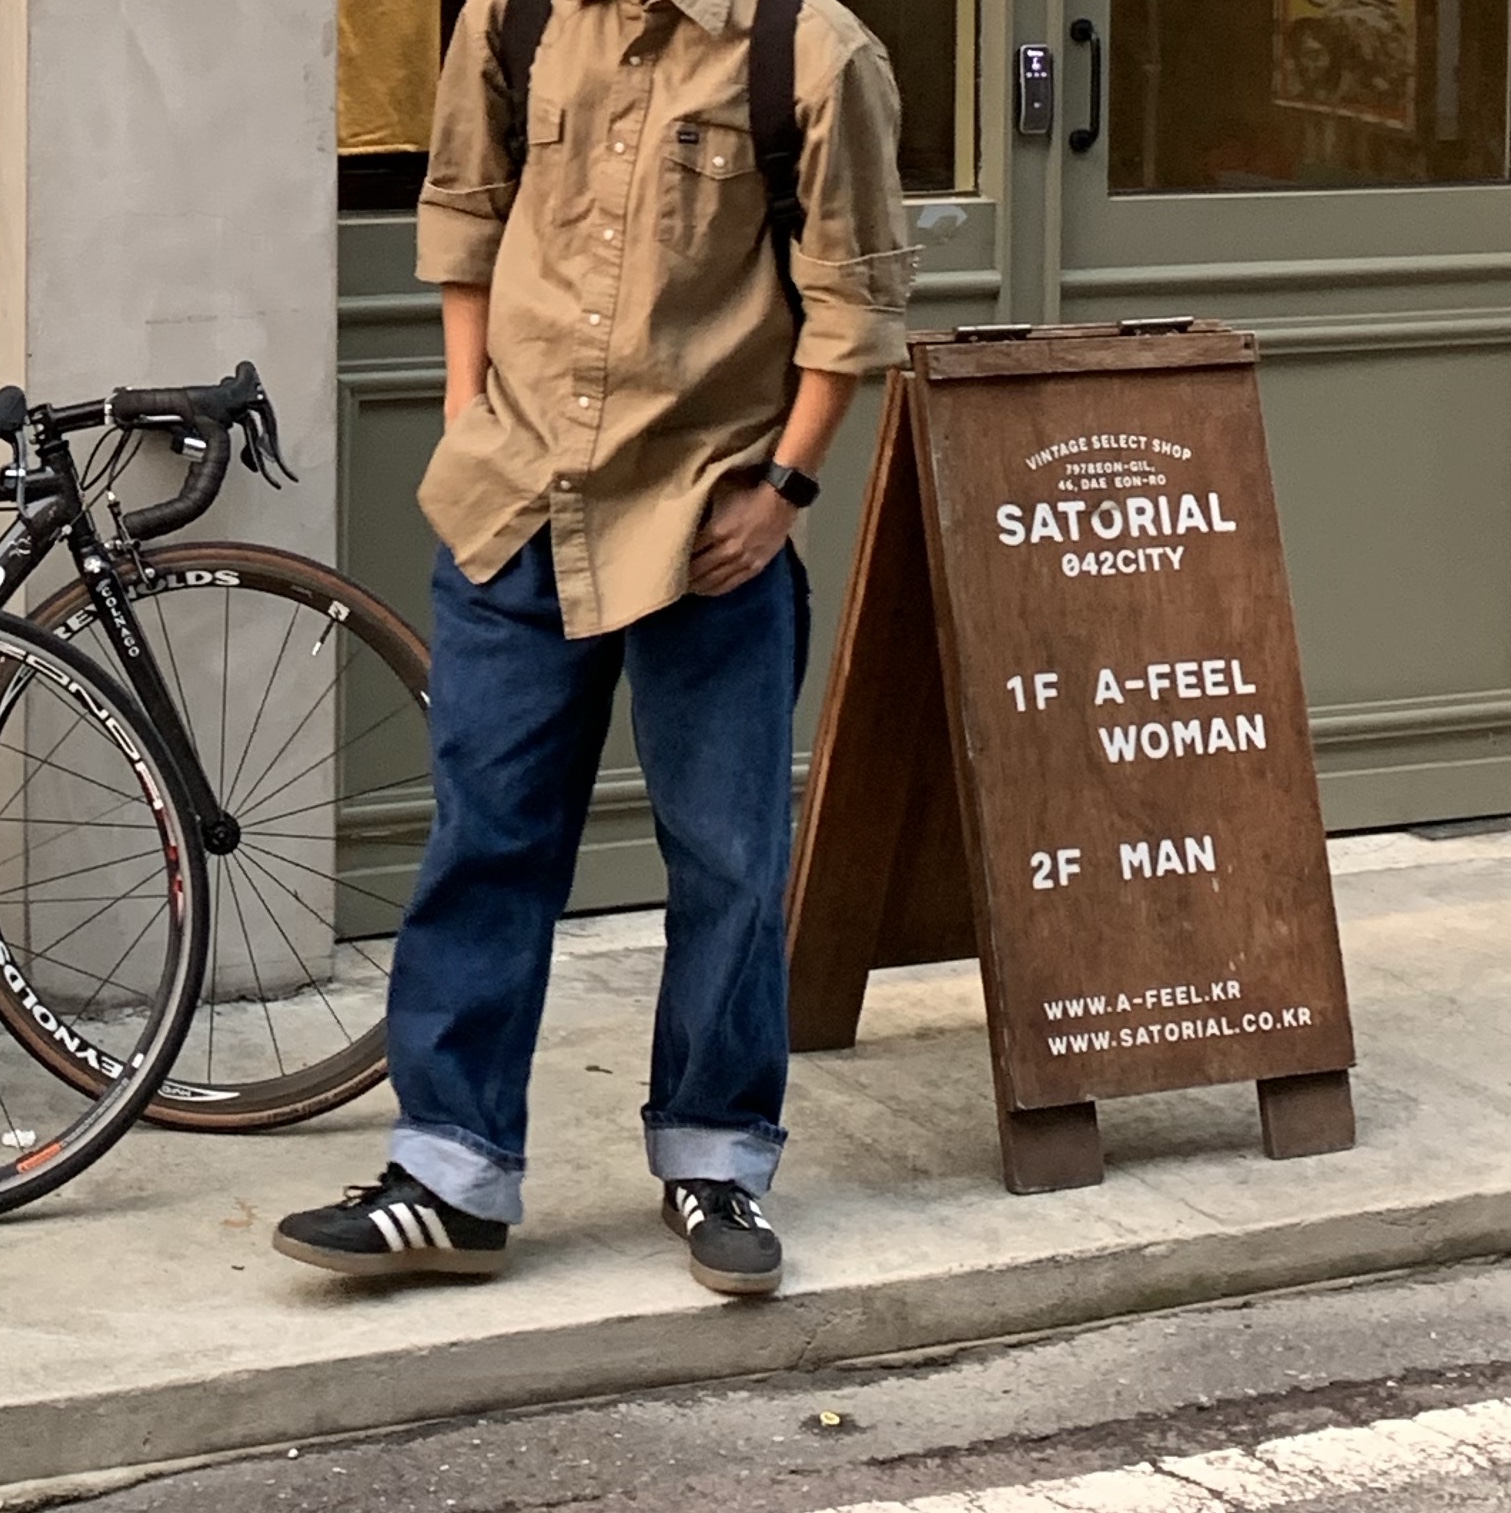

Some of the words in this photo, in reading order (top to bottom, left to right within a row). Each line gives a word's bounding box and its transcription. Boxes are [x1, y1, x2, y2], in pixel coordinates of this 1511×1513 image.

[1024, 436, 1089, 471] VINTAGE
[1091, 434, 1148, 450] SELECT
[1151, 438, 1192, 461] SHOP
[996, 492, 1237, 547] SATORIAL
[1061, 546, 1185, 577] 042CITY
[52, 569, 241, 639] REOLDS
[99, 583, 140, 658] COLNAGO
[1006, 672, 1059, 712] 1F
[1094, 659, 1257, 706] A-FEEL
[1098, 713, 1267, 763] WOMAN
[1029, 848, 1081, 890] 2F
[1119, 834, 1217, 881] MAN
[1043, 979, 1241, 1022] WWW.A-FEEL.KR
[1047, 1006, 1313, 1057] WWW.SATORIAL.CO.KR
